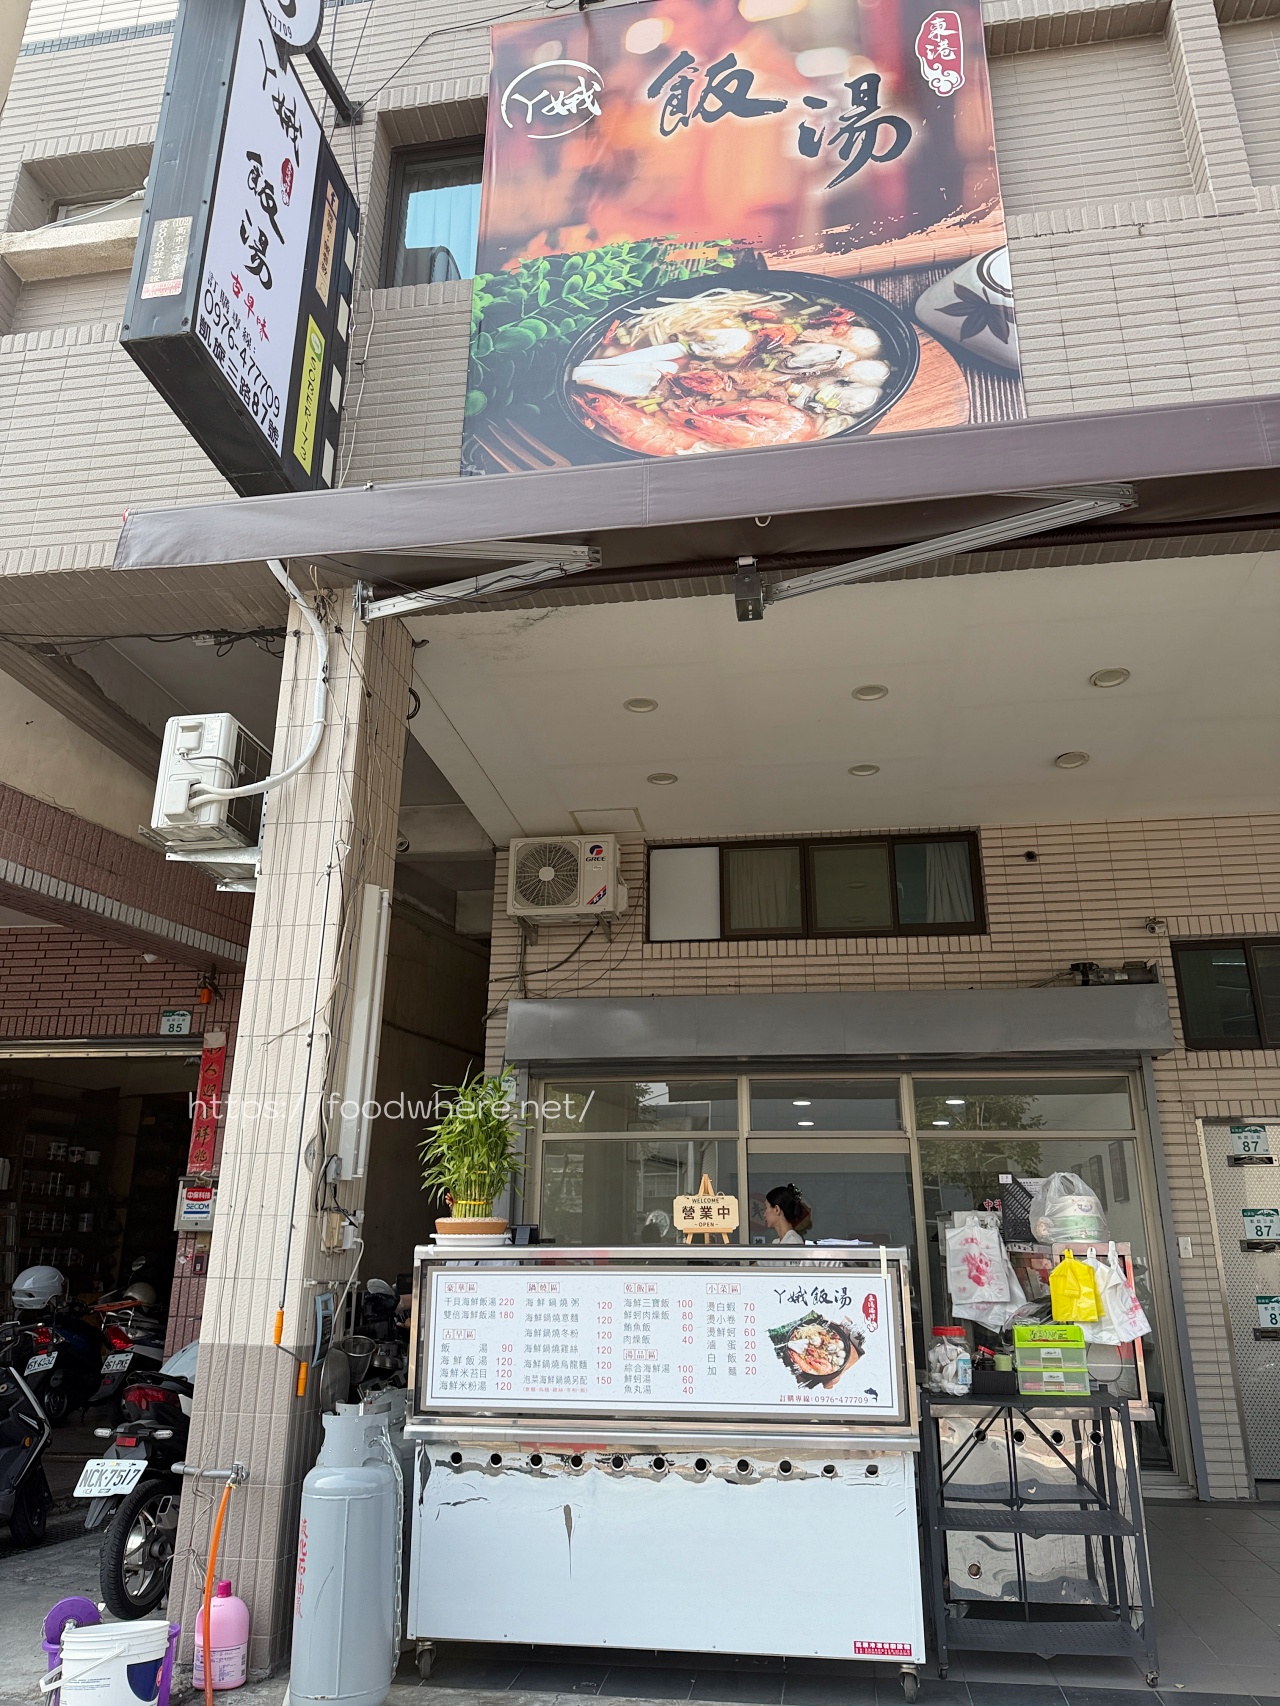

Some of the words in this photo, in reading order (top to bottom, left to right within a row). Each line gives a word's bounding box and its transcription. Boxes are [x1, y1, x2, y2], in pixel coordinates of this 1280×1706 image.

[926, 16, 959, 61] 東港
[647, 50, 913, 191] 飯湯
[231, 271, 270, 343] 古早味
[204, 288, 280, 418] 0976-477709
[198, 314, 280, 449] 凱旋三路87號
[168, 1023, 183, 1033] 85
[1242, 1141, 1259, 1152] 87
[682, 1205, 730, 1220] 營業中
[1255, 1225, 1272, 1237] 87
[498, 1298, 515, 1306] 220
[596, 1301, 613, 1310] 120
[677, 1299, 693, 1308] 100
[743, 1302, 755, 1311] 70
[499, 1311, 515, 1319] 180
[681, 1311, 693, 1320] 80
[743, 1315, 756, 1324] 70
[1269, 1313, 1280, 1326] 8
[596, 1316, 613, 1325] 120
[682, 1323, 694, 1332] 60
[596, 1331, 613, 1339] 120
[743, 1328, 756, 1337] 60
[682, 1336, 694, 1344] 40
[501, 1343, 513, 1353] 90
[744, 1340, 756, 1350] 20
[596, 1346, 612, 1354] 120
[496, 1357, 513, 1366] 120
[744, 1353, 757, 1362] 20
[596, 1361, 612, 1370] 120
[677, 1365, 694, 1373] 100
[495, 1369, 513, 1378] 120
[745, 1366, 757, 1375] 20
[596, 1376, 612, 1385] 150
[682, 1375, 694, 1384] 60
[495, 1382, 512, 1391] 120
[682, 1386, 694, 1394] 40
